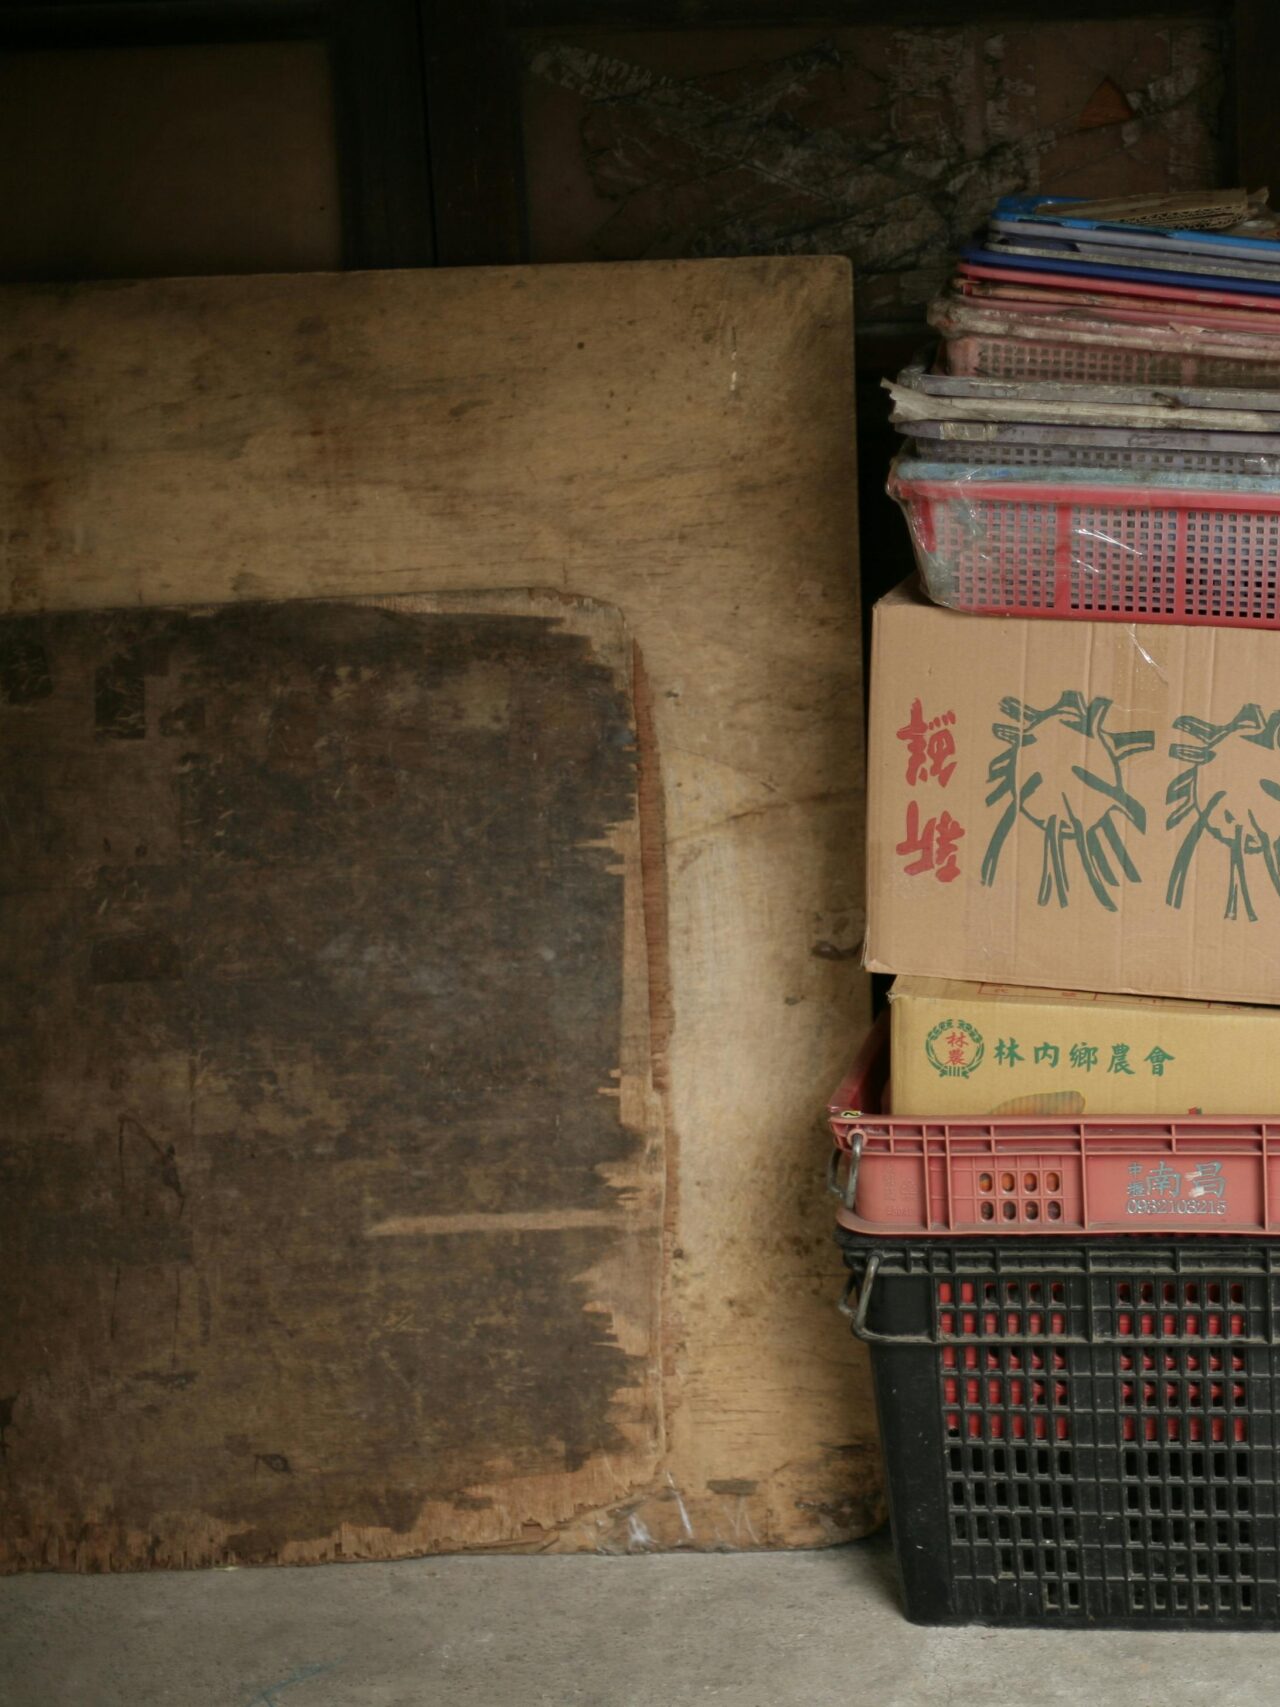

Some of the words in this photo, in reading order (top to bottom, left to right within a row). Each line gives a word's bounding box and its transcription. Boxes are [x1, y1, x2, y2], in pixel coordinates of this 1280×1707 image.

[896, 697, 965, 883] 新鮮
[993, 1037, 1175, 1077] 林內鄉農會
